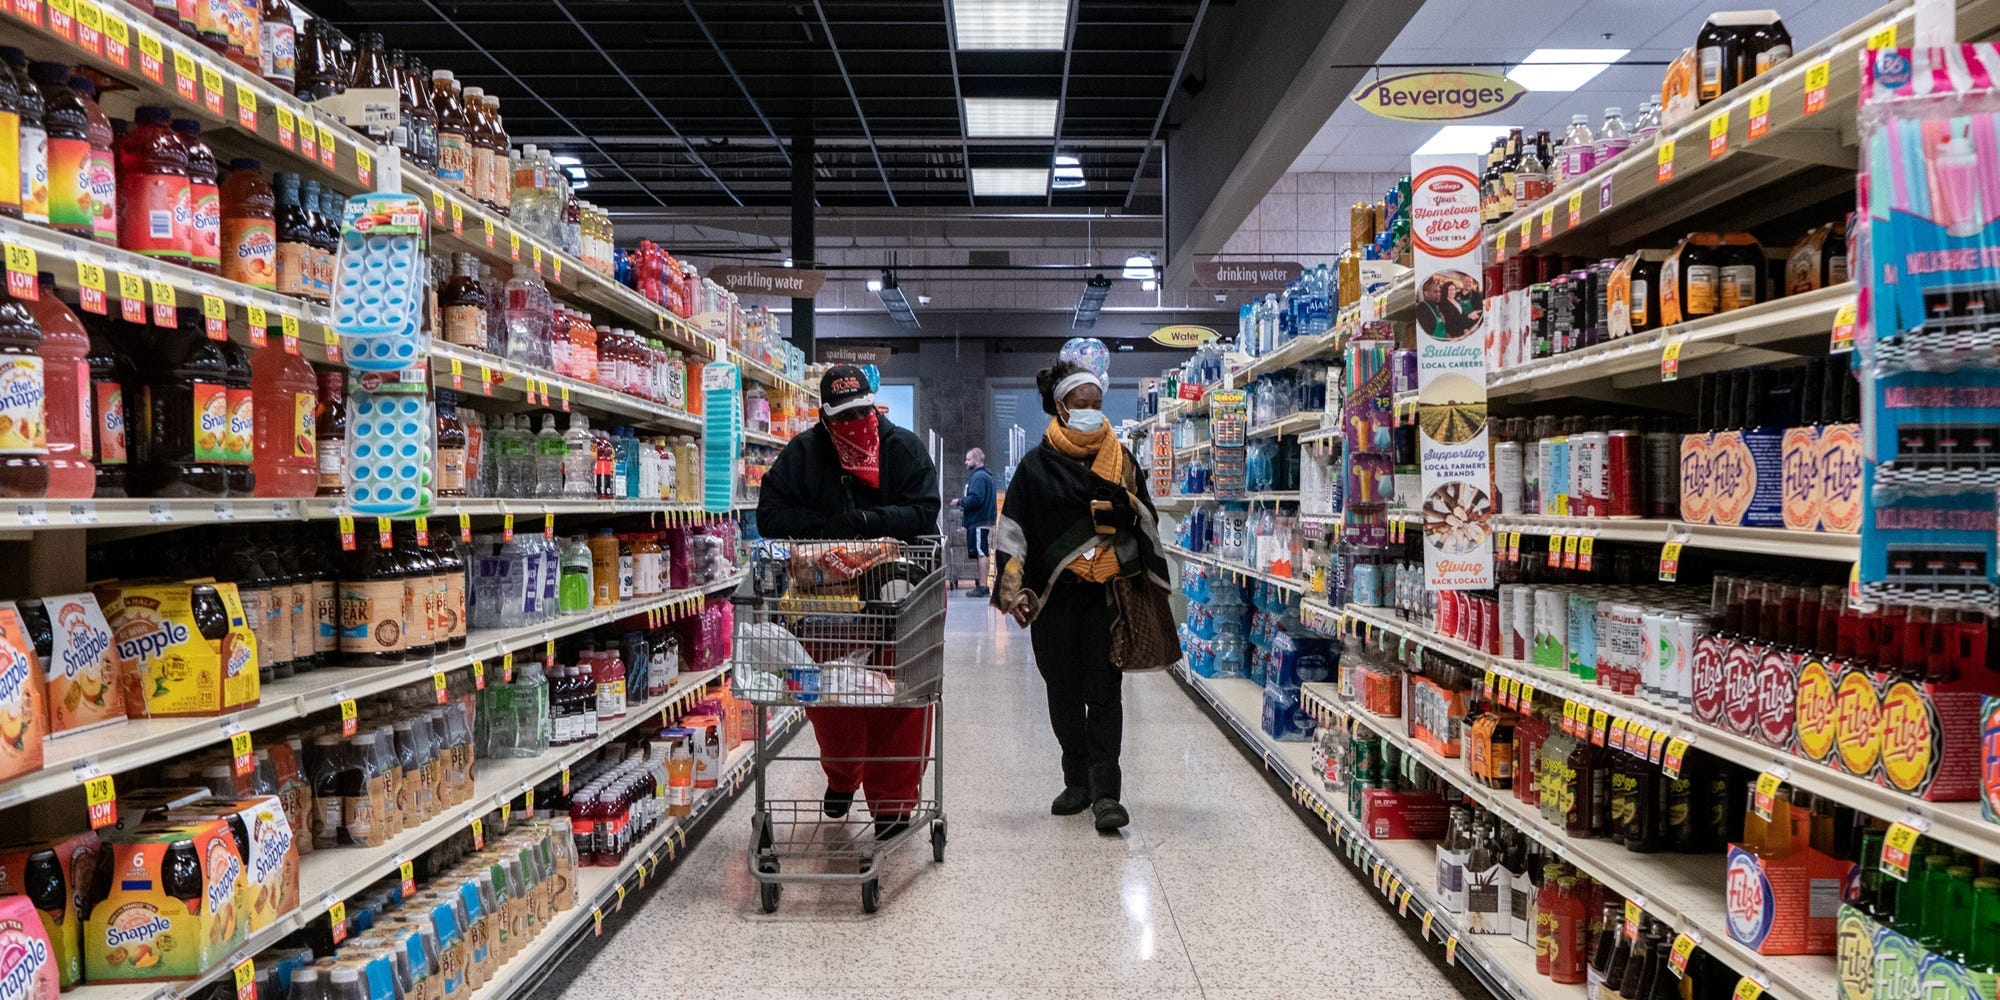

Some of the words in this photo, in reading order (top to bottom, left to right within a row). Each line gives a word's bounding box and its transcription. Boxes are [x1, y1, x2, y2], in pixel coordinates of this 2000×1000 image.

[51, 9, 70, 28] LOW
[79, 25, 98, 44] LOW
[105, 36, 125, 56] LOW
[141, 54, 159, 72] LOW
[177, 74, 193, 91] LOW
[205, 88, 220, 105] LOW
[1379, 86, 1504, 109] Beverages
[240, 107, 254, 121] LOW
[1433, 195, 1457, 206] Your
[1414, 205, 1479, 219] Hometown
[1425, 219, 1471, 236] Store
[10, 272, 32, 288] LOW
[726, 272, 773, 290] sparkling
[775, 275, 804, 289] water
[1217, 267, 1258, 284] drinking
[1259, 269, 1287, 281] water
[82, 287, 101, 303] LOW
[124, 297, 140, 312] LOW
[156, 304, 172, 317] LOW
[208, 318, 222, 331] LOW
[251, 326, 264, 338] LOW
[284, 335, 297, 347] LOW
[1171, 332, 1200, 342] Water
[826, 349, 856, 361] sparkling
[857, 351, 876, 361] water
[1422, 345, 1482, 360] Building
[10, 381, 33, 395] diet
[1424, 448, 1486, 461] Supporting
[1683, 451, 1712, 498] Fitz's
[1714, 450, 1742, 497] Fitz's
[1785, 448, 1818, 500] Fitz's
[1822, 446, 1862, 501] Fitz's
[1233, 519, 1242, 547] core
[1338, 556, 1346, 588] penta
[1436, 559, 1484, 577] Giving
[73, 630, 90, 648] diet
[64, 628, 108, 677] Snapple
[1694, 651, 1723, 699] Fitz's
[1725, 660, 1756, 711] Fitz's
[1757, 669, 1794, 722] Fitz's
[1799, 678, 1835, 734] Fitz's
[1837, 689, 1881, 747] Fitz's
[1883, 700, 1929, 762] Fitz's
[236, 756, 250, 768] LOW
[91, 803, 110, 819] LOW
[264, 835, 276, 854] diet
[133, 852, 144, 867] 6
[256, 832, 290, 883] Snapple
[209, 856, 240, 913] Snapple
[1728, 868, 1763, 921] Fitz's
[8, 921, 22, 929] TEA
[107, 917, 171, 946] Snapple
